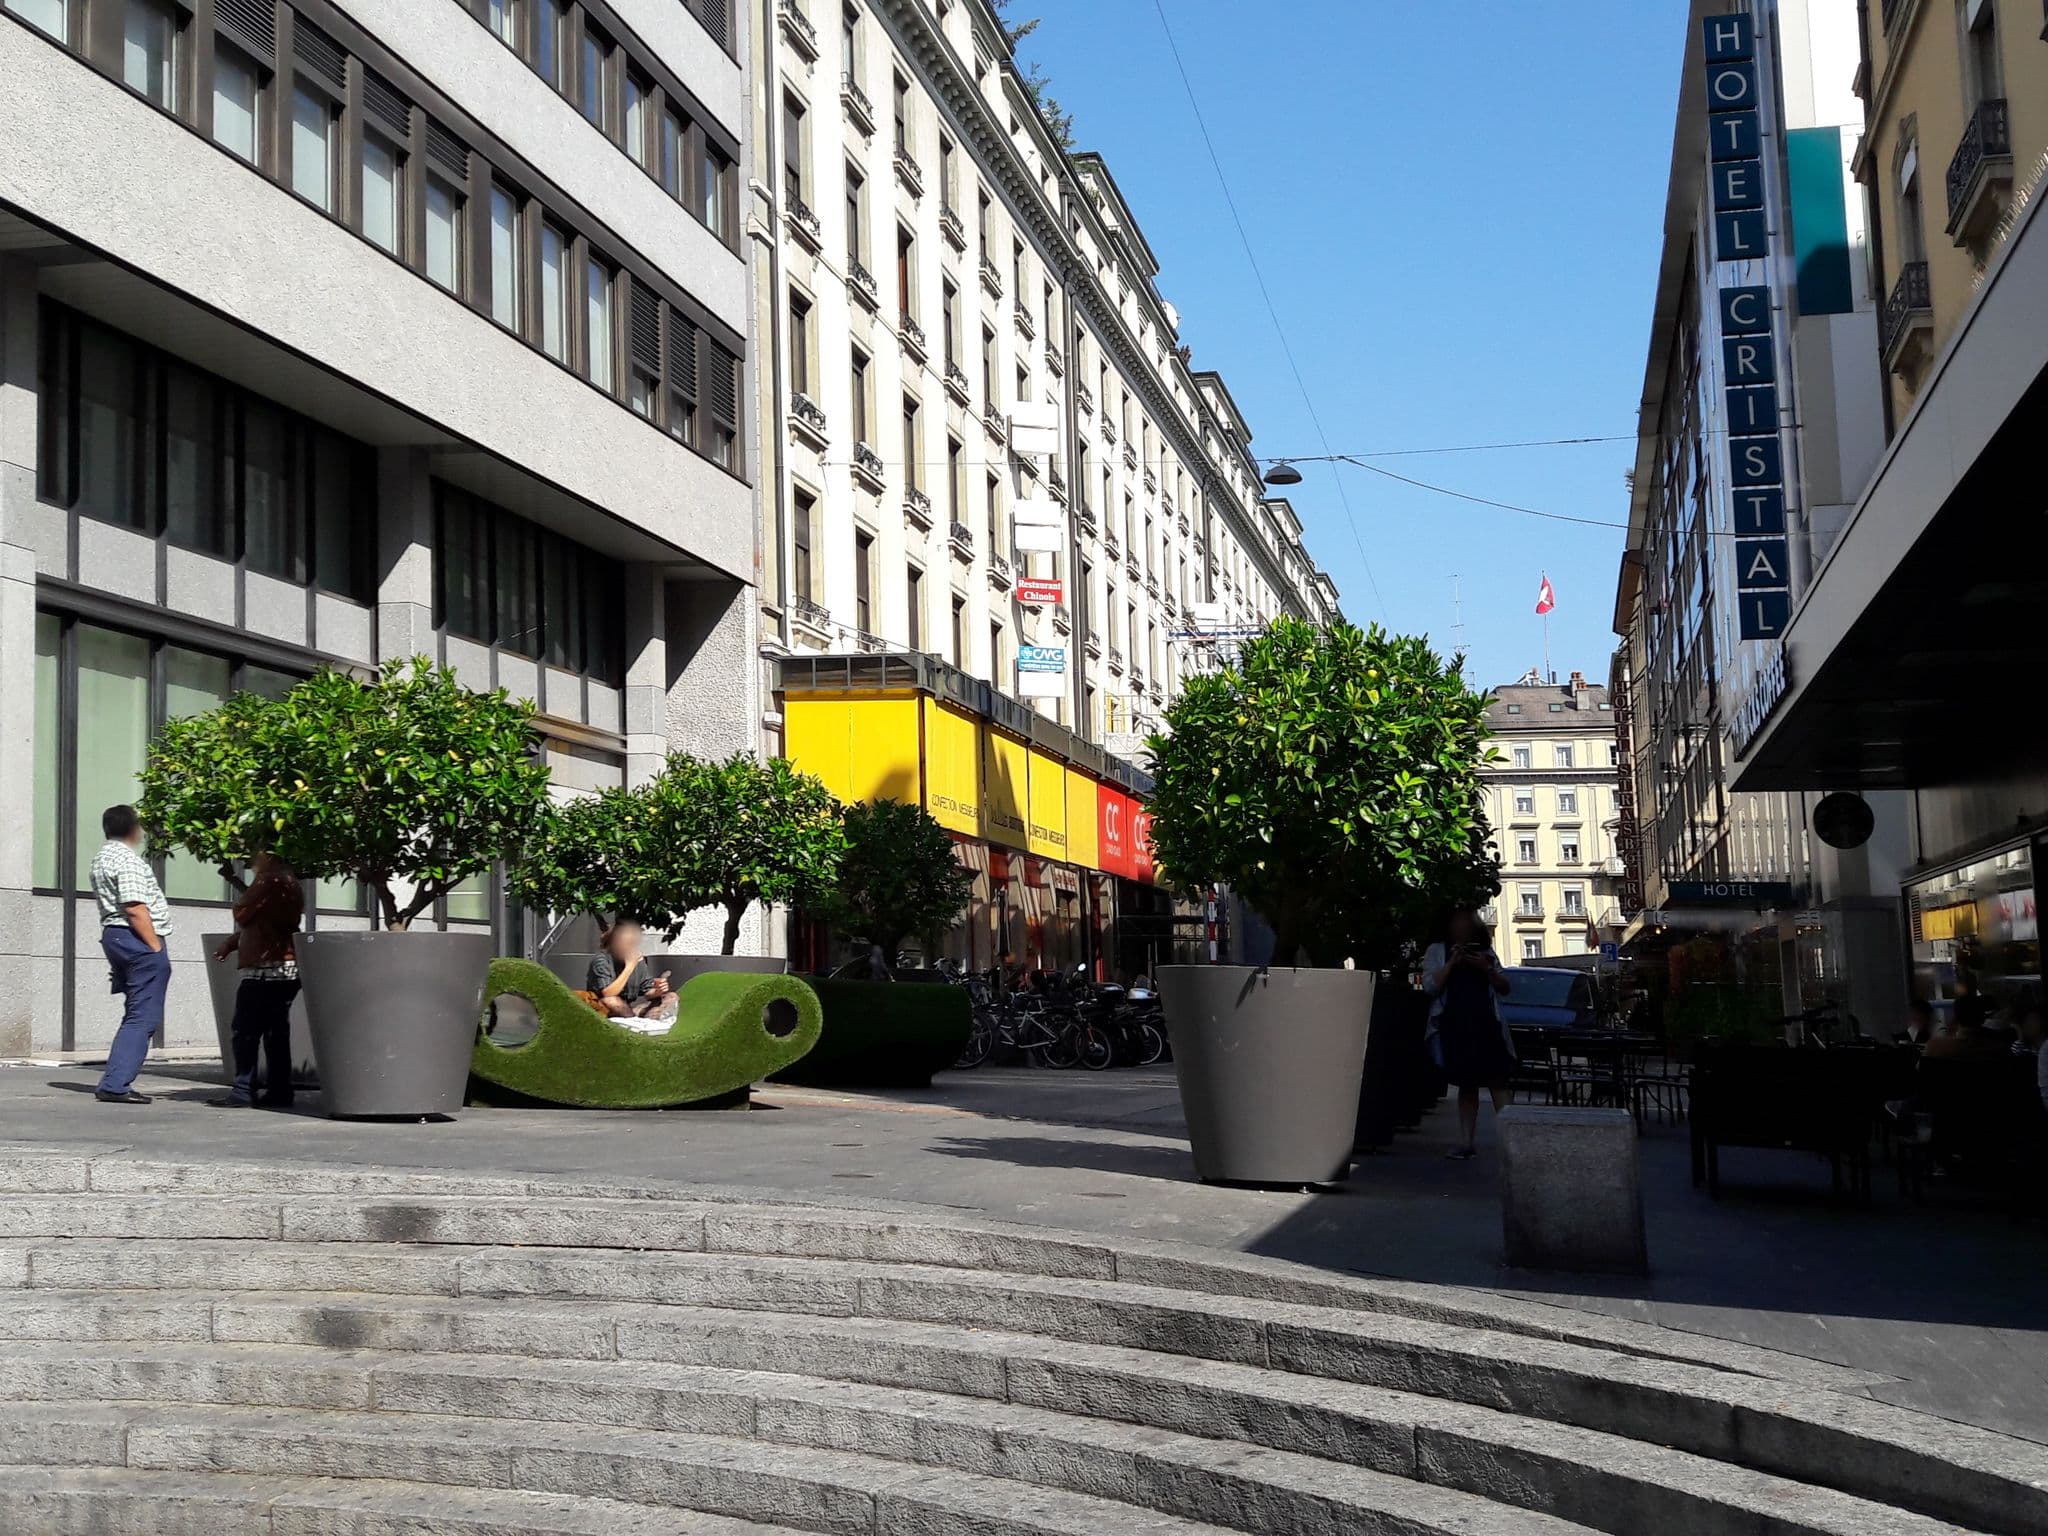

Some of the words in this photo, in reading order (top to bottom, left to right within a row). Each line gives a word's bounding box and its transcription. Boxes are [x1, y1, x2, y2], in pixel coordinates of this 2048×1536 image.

[1713, 21, 1750, 250] HOTEL
[1729, 293, 1778, 632] CRISTAL
[1018, 580, 1061, 590] Restaurant
[1024, 591, 1056, 601] Chinois
[1614, 681, 1629, 752] HOTEL
[1703, 884, 1756, 897] HOTEL
